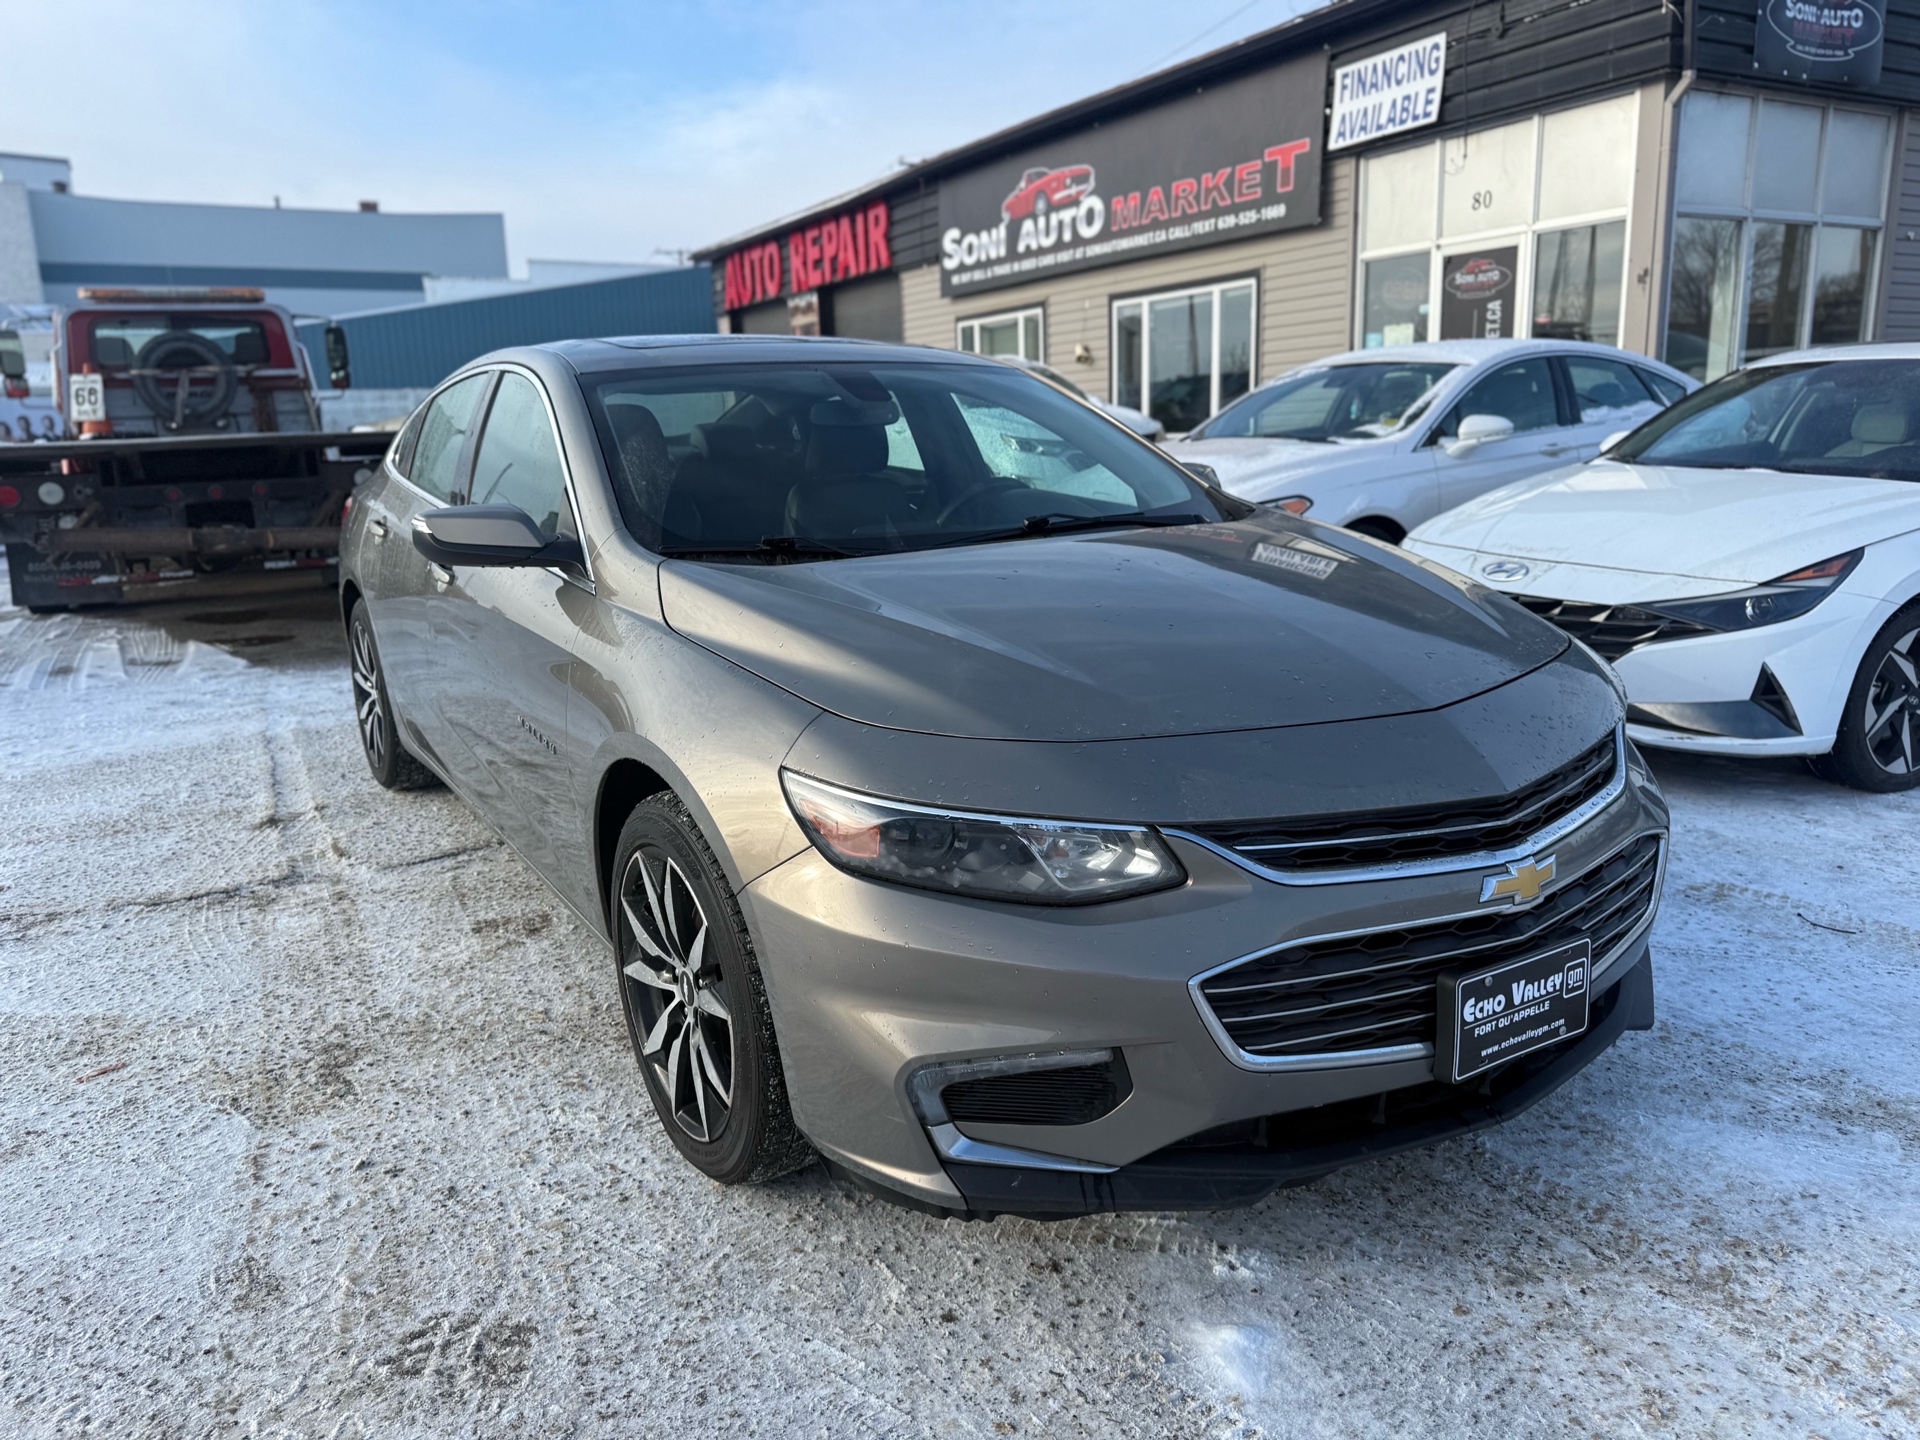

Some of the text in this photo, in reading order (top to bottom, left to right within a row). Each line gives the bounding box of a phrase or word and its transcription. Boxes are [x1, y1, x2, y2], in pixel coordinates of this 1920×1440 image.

[1785, 0, 1864, 29] SONI AUTO
[1339, 42, 1441, 104] FINANCING
[1334, 85, 1437, 144] AVAILABLE
[942, 137, 1311, 270] SONI AUTO MARKET
[1472, 190, 1493, 211] 80
[1168, 217, 1216, 240] CALL/TEXT
[724, 200, 891, 311] AUTO REPAIR
[1463, 972, 1563, 1023] ECHO VALLEY
[1568, 967, 1583, 989] gm
[1474, 1000, 1550, 1038] FORT QU'APPELLE
[1481, 1018, 1565, 1057] www.echovalleygm.com
